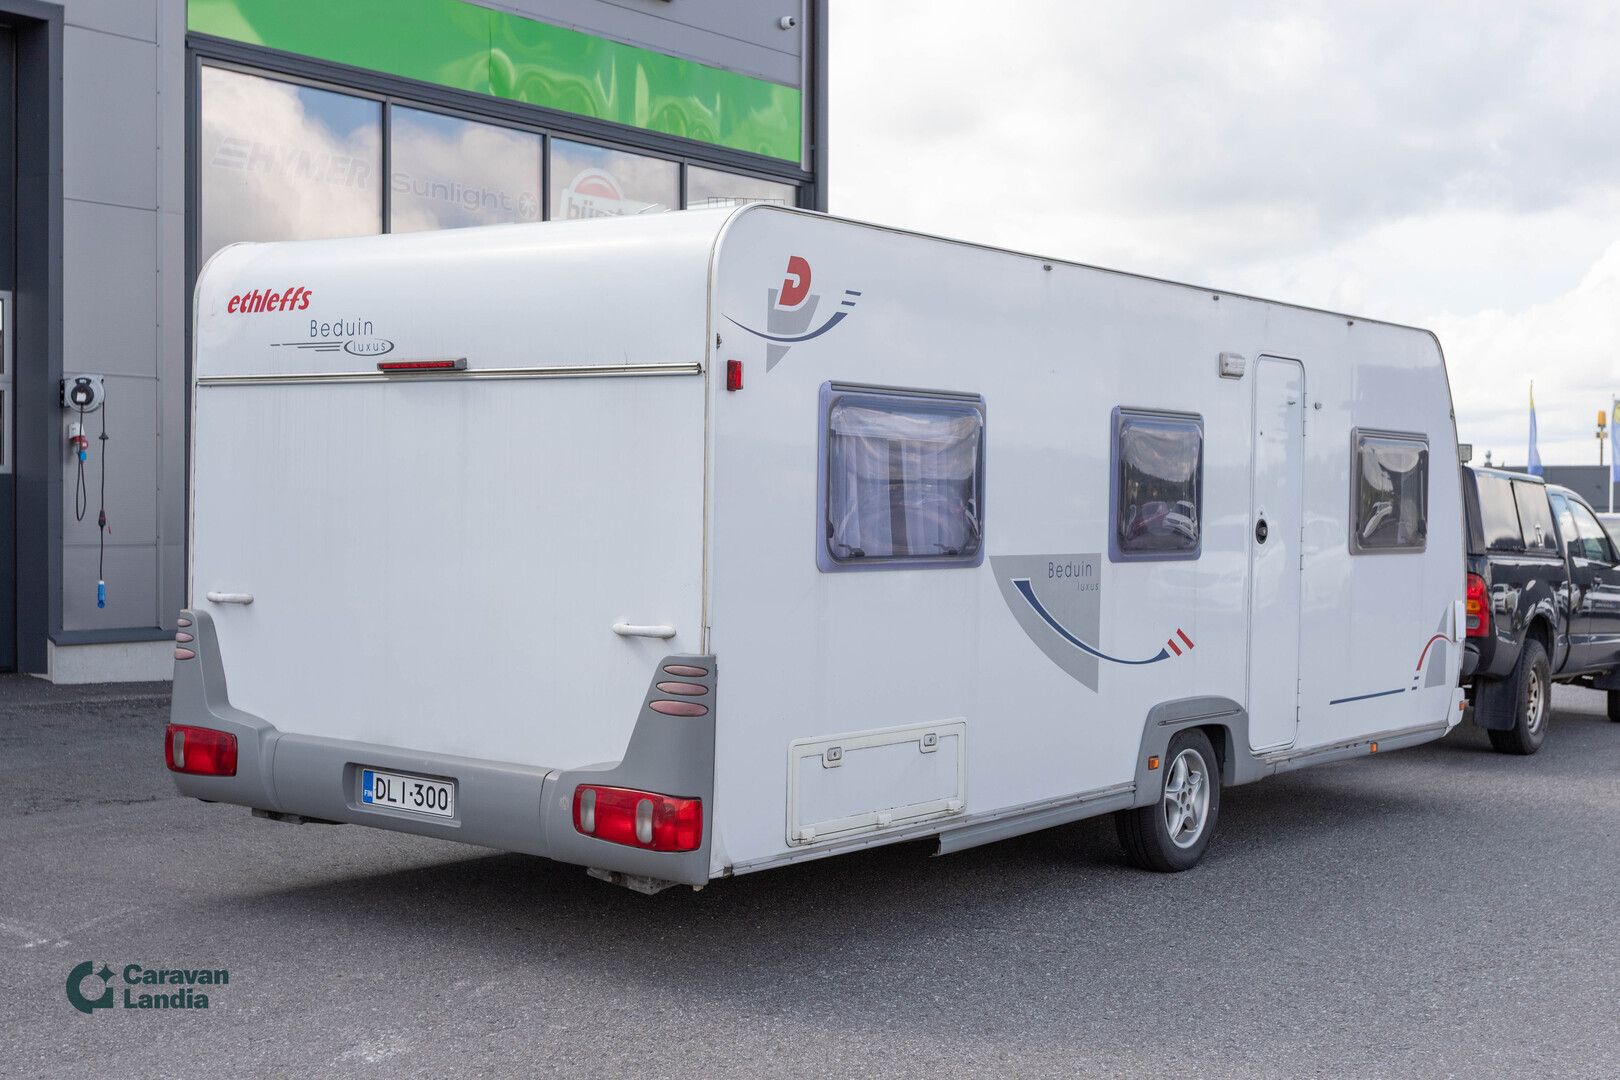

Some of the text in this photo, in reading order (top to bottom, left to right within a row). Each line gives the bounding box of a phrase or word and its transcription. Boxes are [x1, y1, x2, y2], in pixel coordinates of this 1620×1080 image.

[391, 172, 513, 211] Sunlight
[227, 286, 313, 314] ethleffs
[310, 318, 374, 338] Beduin
[353, 341, 386, 352] luxus
[1048, 561, 1092, 579] Beduin
[1077, 583, 1099, 592] luxus
